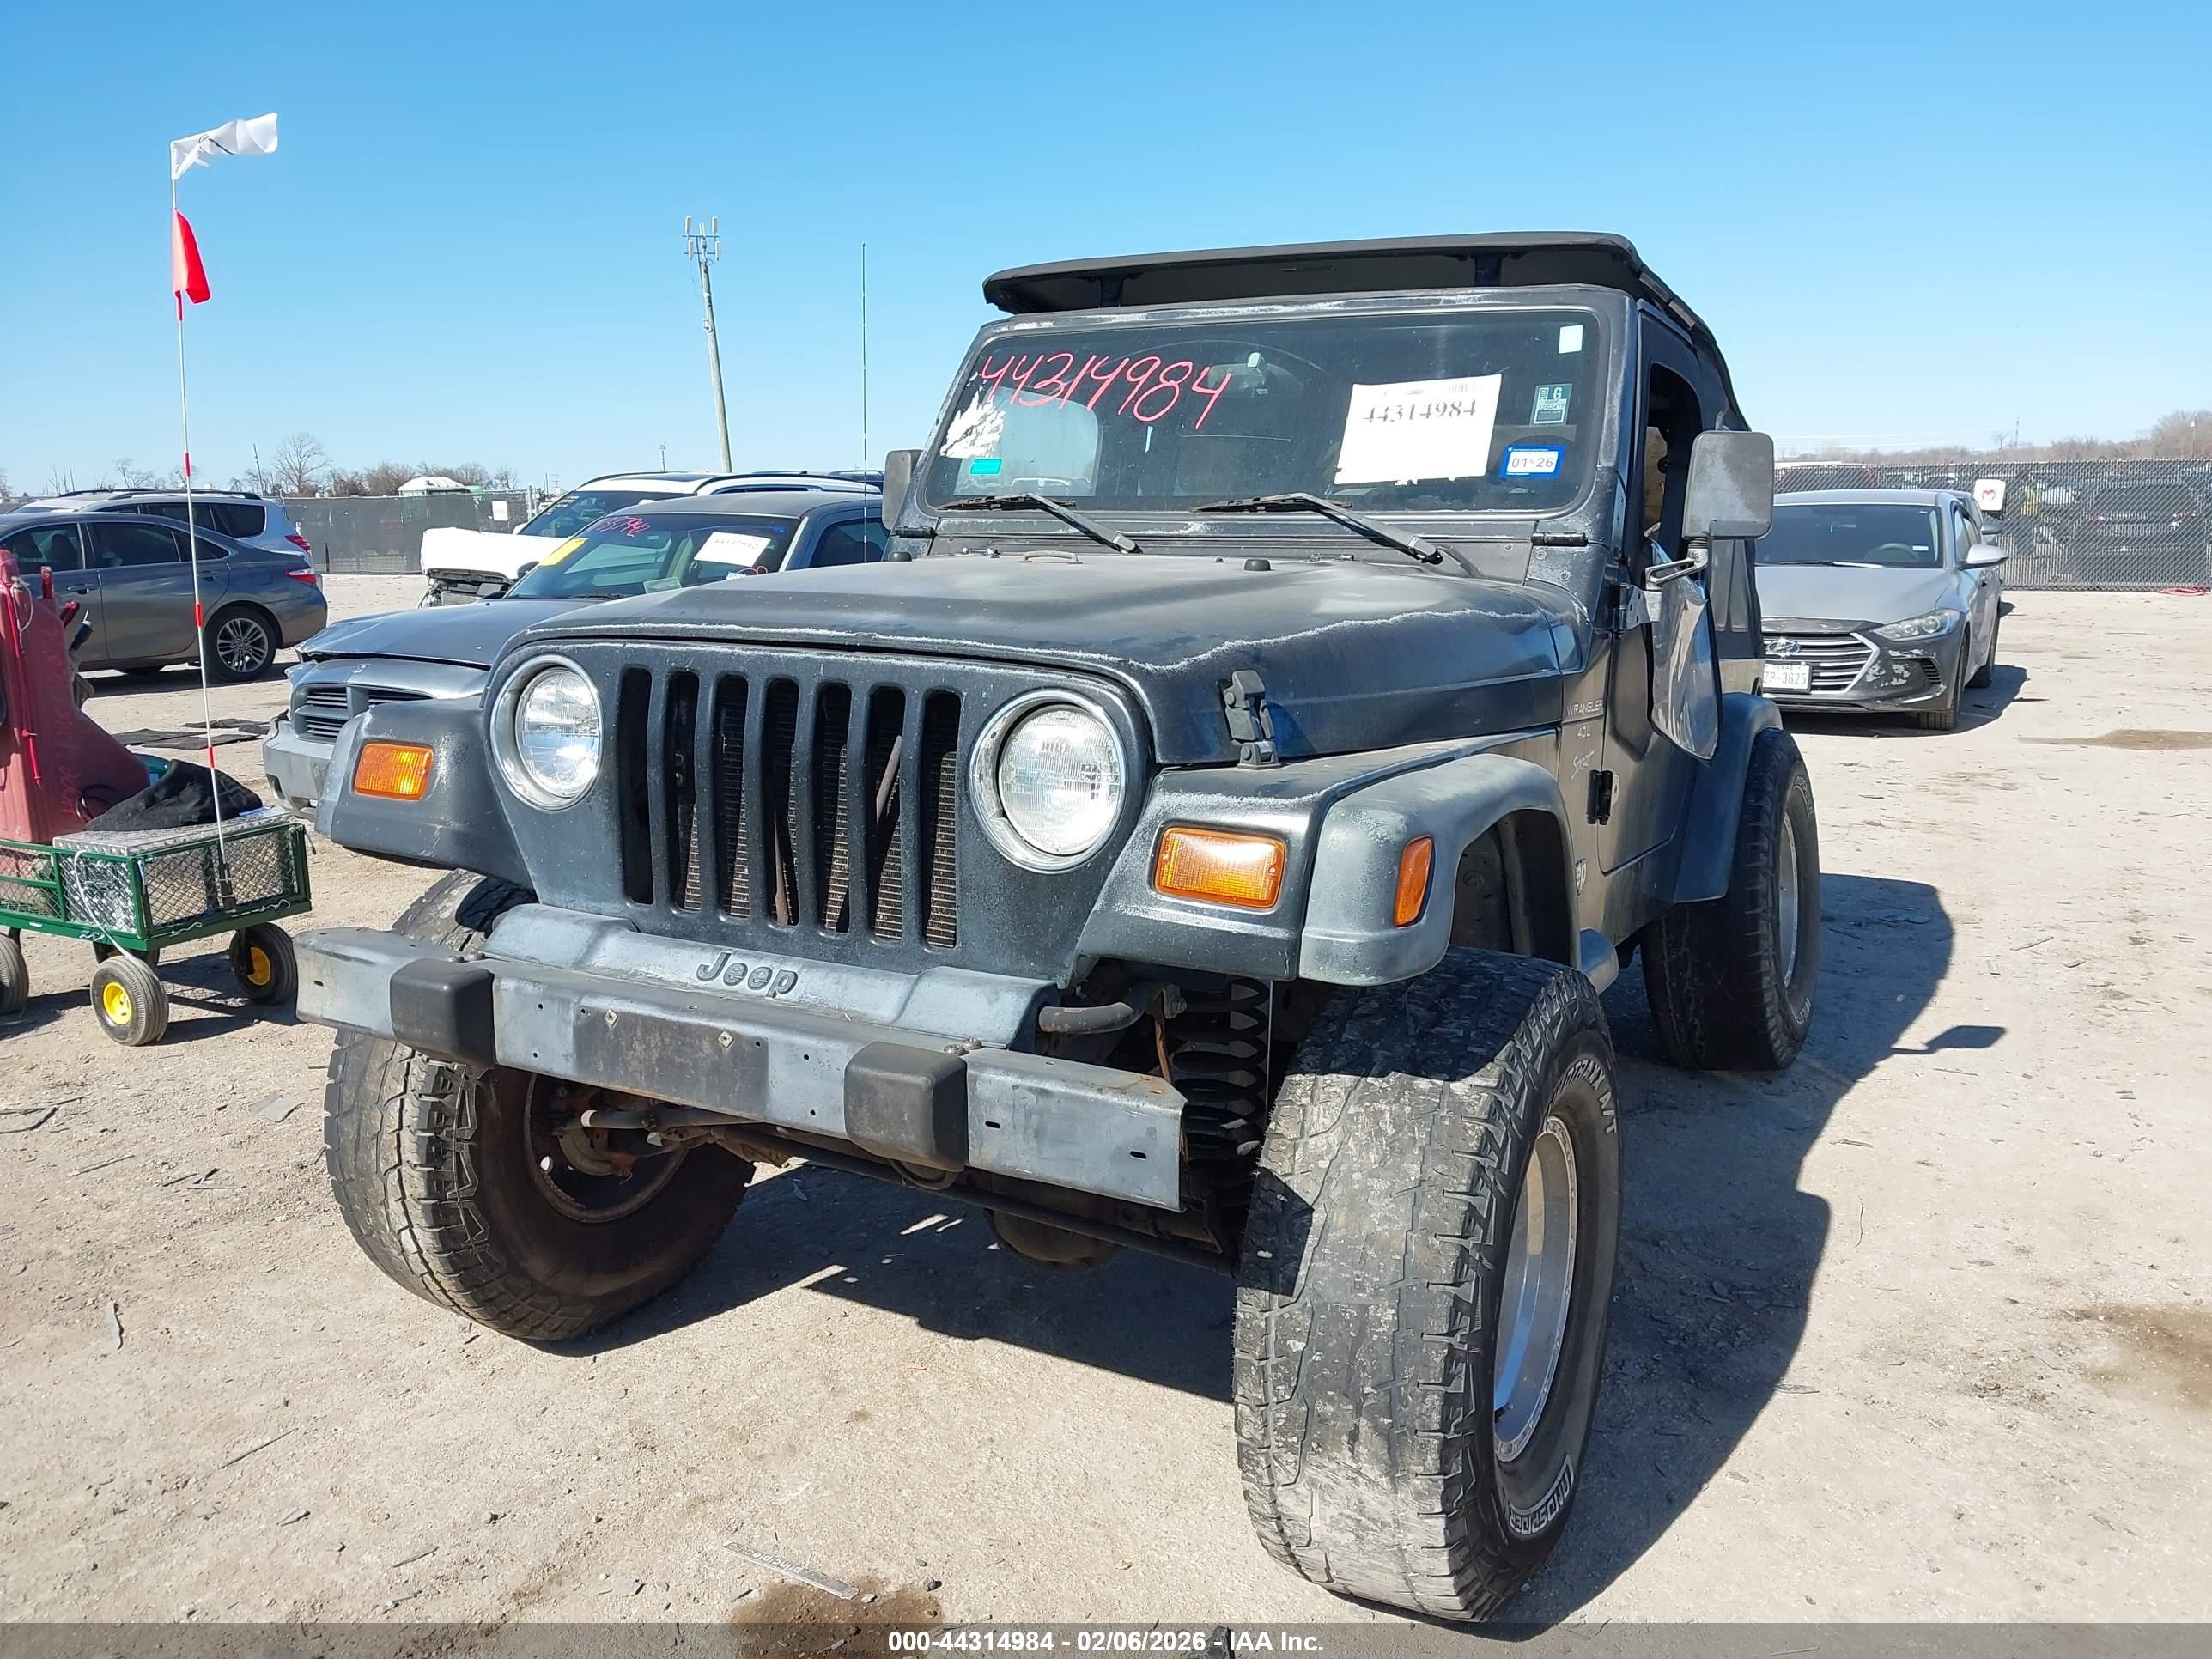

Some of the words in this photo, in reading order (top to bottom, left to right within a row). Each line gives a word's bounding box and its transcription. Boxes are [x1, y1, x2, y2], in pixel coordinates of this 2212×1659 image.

[981, 352, 1232, 431] 44314984
[1553, 386, 1563, 400] G
[1363, 398, 1477, 423] 44314984
[1511, 457, 1528, 468] 01
[1536, 457, 1554, 468] 26
[1763, 671, 1807, 685] ZP-3625
[1566, 699, 1604, 717] WRANGLER
[1576, 861, 1588, 891] ep
[696, 951, 799, 999] Jeep
[1598, 1091, 1618, 1135] A/T
[1508, 1454, 1575, 1535] LANDSPIDER
